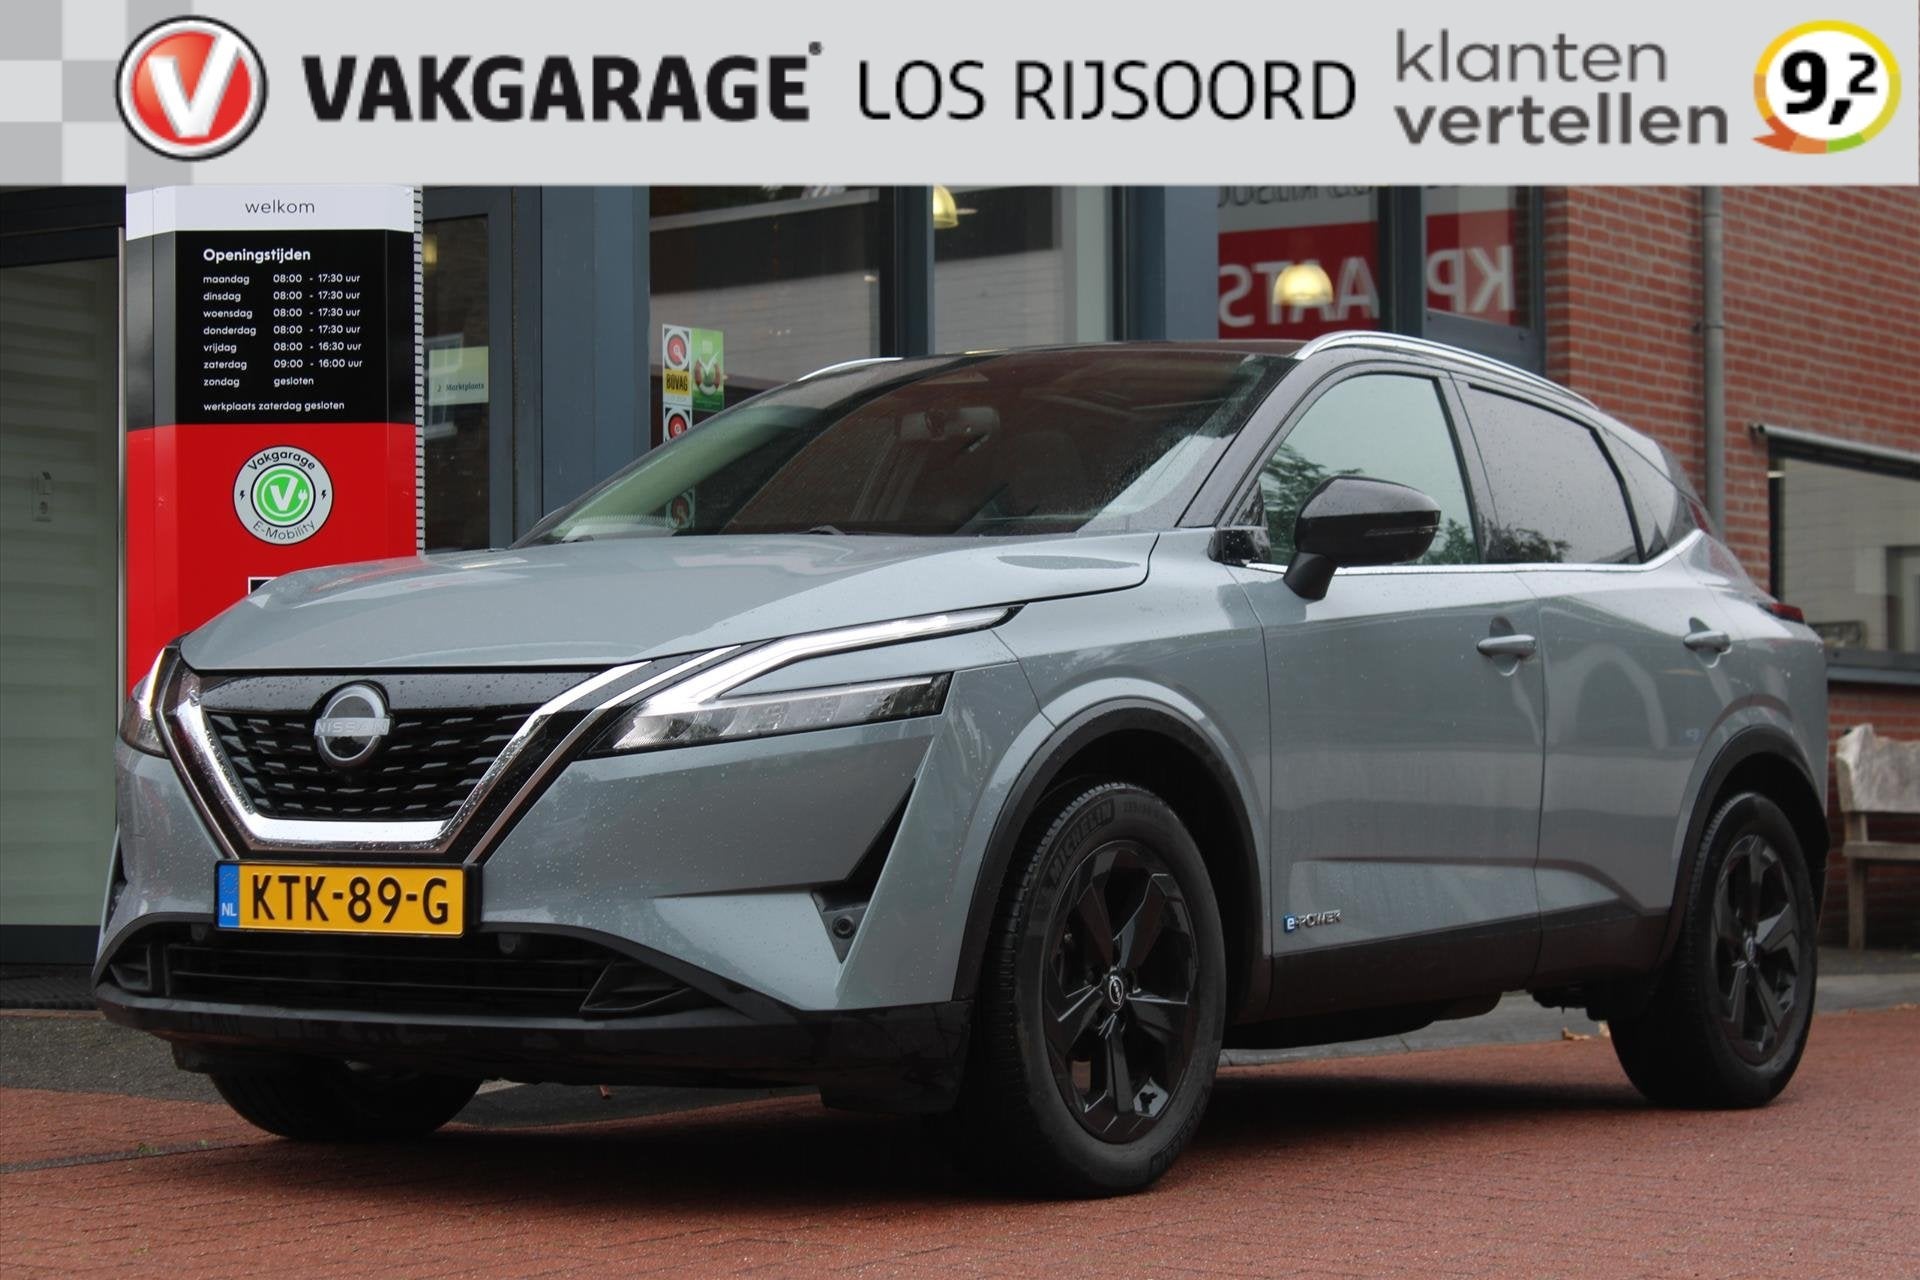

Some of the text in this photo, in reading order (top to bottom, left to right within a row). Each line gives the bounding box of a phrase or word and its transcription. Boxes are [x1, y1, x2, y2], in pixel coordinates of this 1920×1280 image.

[245, 199, 315, 214] welkom
[203, 248, 311, 264] Openingstijden
[203, 274, 250, 286] maandag
[273, 274, 303, 283] 08:00
[318, 273, 343, 283] 17:30
[345, 274, 361, 282] uur
[203, 291, 242, 303] dinsdag
[273, 291, 303, 300] 08:00
[318, 290, 343, 300] 17:30
[345, 291, 361, 299] uur
[203, 308, 253, 320] woensdag
[273, 308, 303, 317] 08:00
[318, 307, 343, 317] 17:30
[345, 308, 361, 316] uur
[203, 325, 257, 337] donderdag
[273, 325, 303, 334] 08:00
[318, 324, 343, 334] 17:30
[345, 325, 361, 333] uur
[203, 342, 237, 354] vrijdag
[273, 342, 303, 351] 08:00
[318, 341, 345, 351] 16:30
[346, 342, 362, 350] uur
[203, 360, 248, 371] zaterdag
[273, 359, 303, 368] 09:00
[318, 358, 346, 368] 16:00
[347, 359, 363, 367] uur
[203, 376, 314, 388] zondag gesloten
[203, 400, 345, 413] werkplaats zaterdag gesloten
[247, 451, 316, 470] Vakgarage
[252, 520, 316, 540] E-Mobility
[315, 720, 388, 734] NISSAN
[252, 874, 449, 926] KTK-89-G
[221, 902, 237, 917] NL
